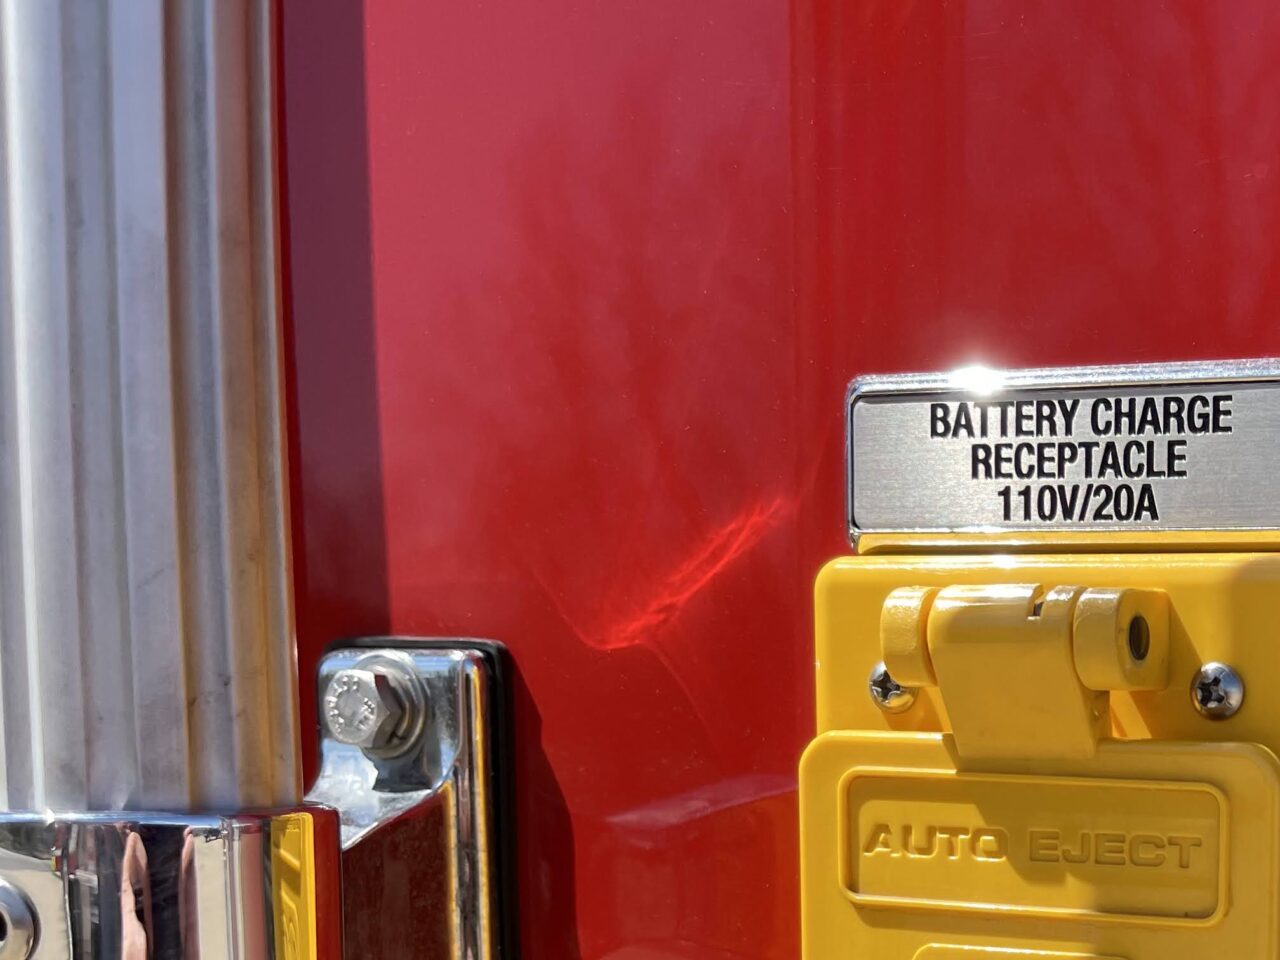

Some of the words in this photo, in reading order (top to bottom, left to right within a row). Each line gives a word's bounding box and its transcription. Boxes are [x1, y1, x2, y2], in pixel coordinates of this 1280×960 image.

[930, 399, 1079, 438] BATTERY
[1091, 395, 1233, 435] CHARGE
[971, 440, 1188, 479] RECEPTACLE
[998, 484, 1158, 522] 110V/20A
[863, 824, 1008, 862] AUTO
[1029, 830, 1202, 869] EJECT
